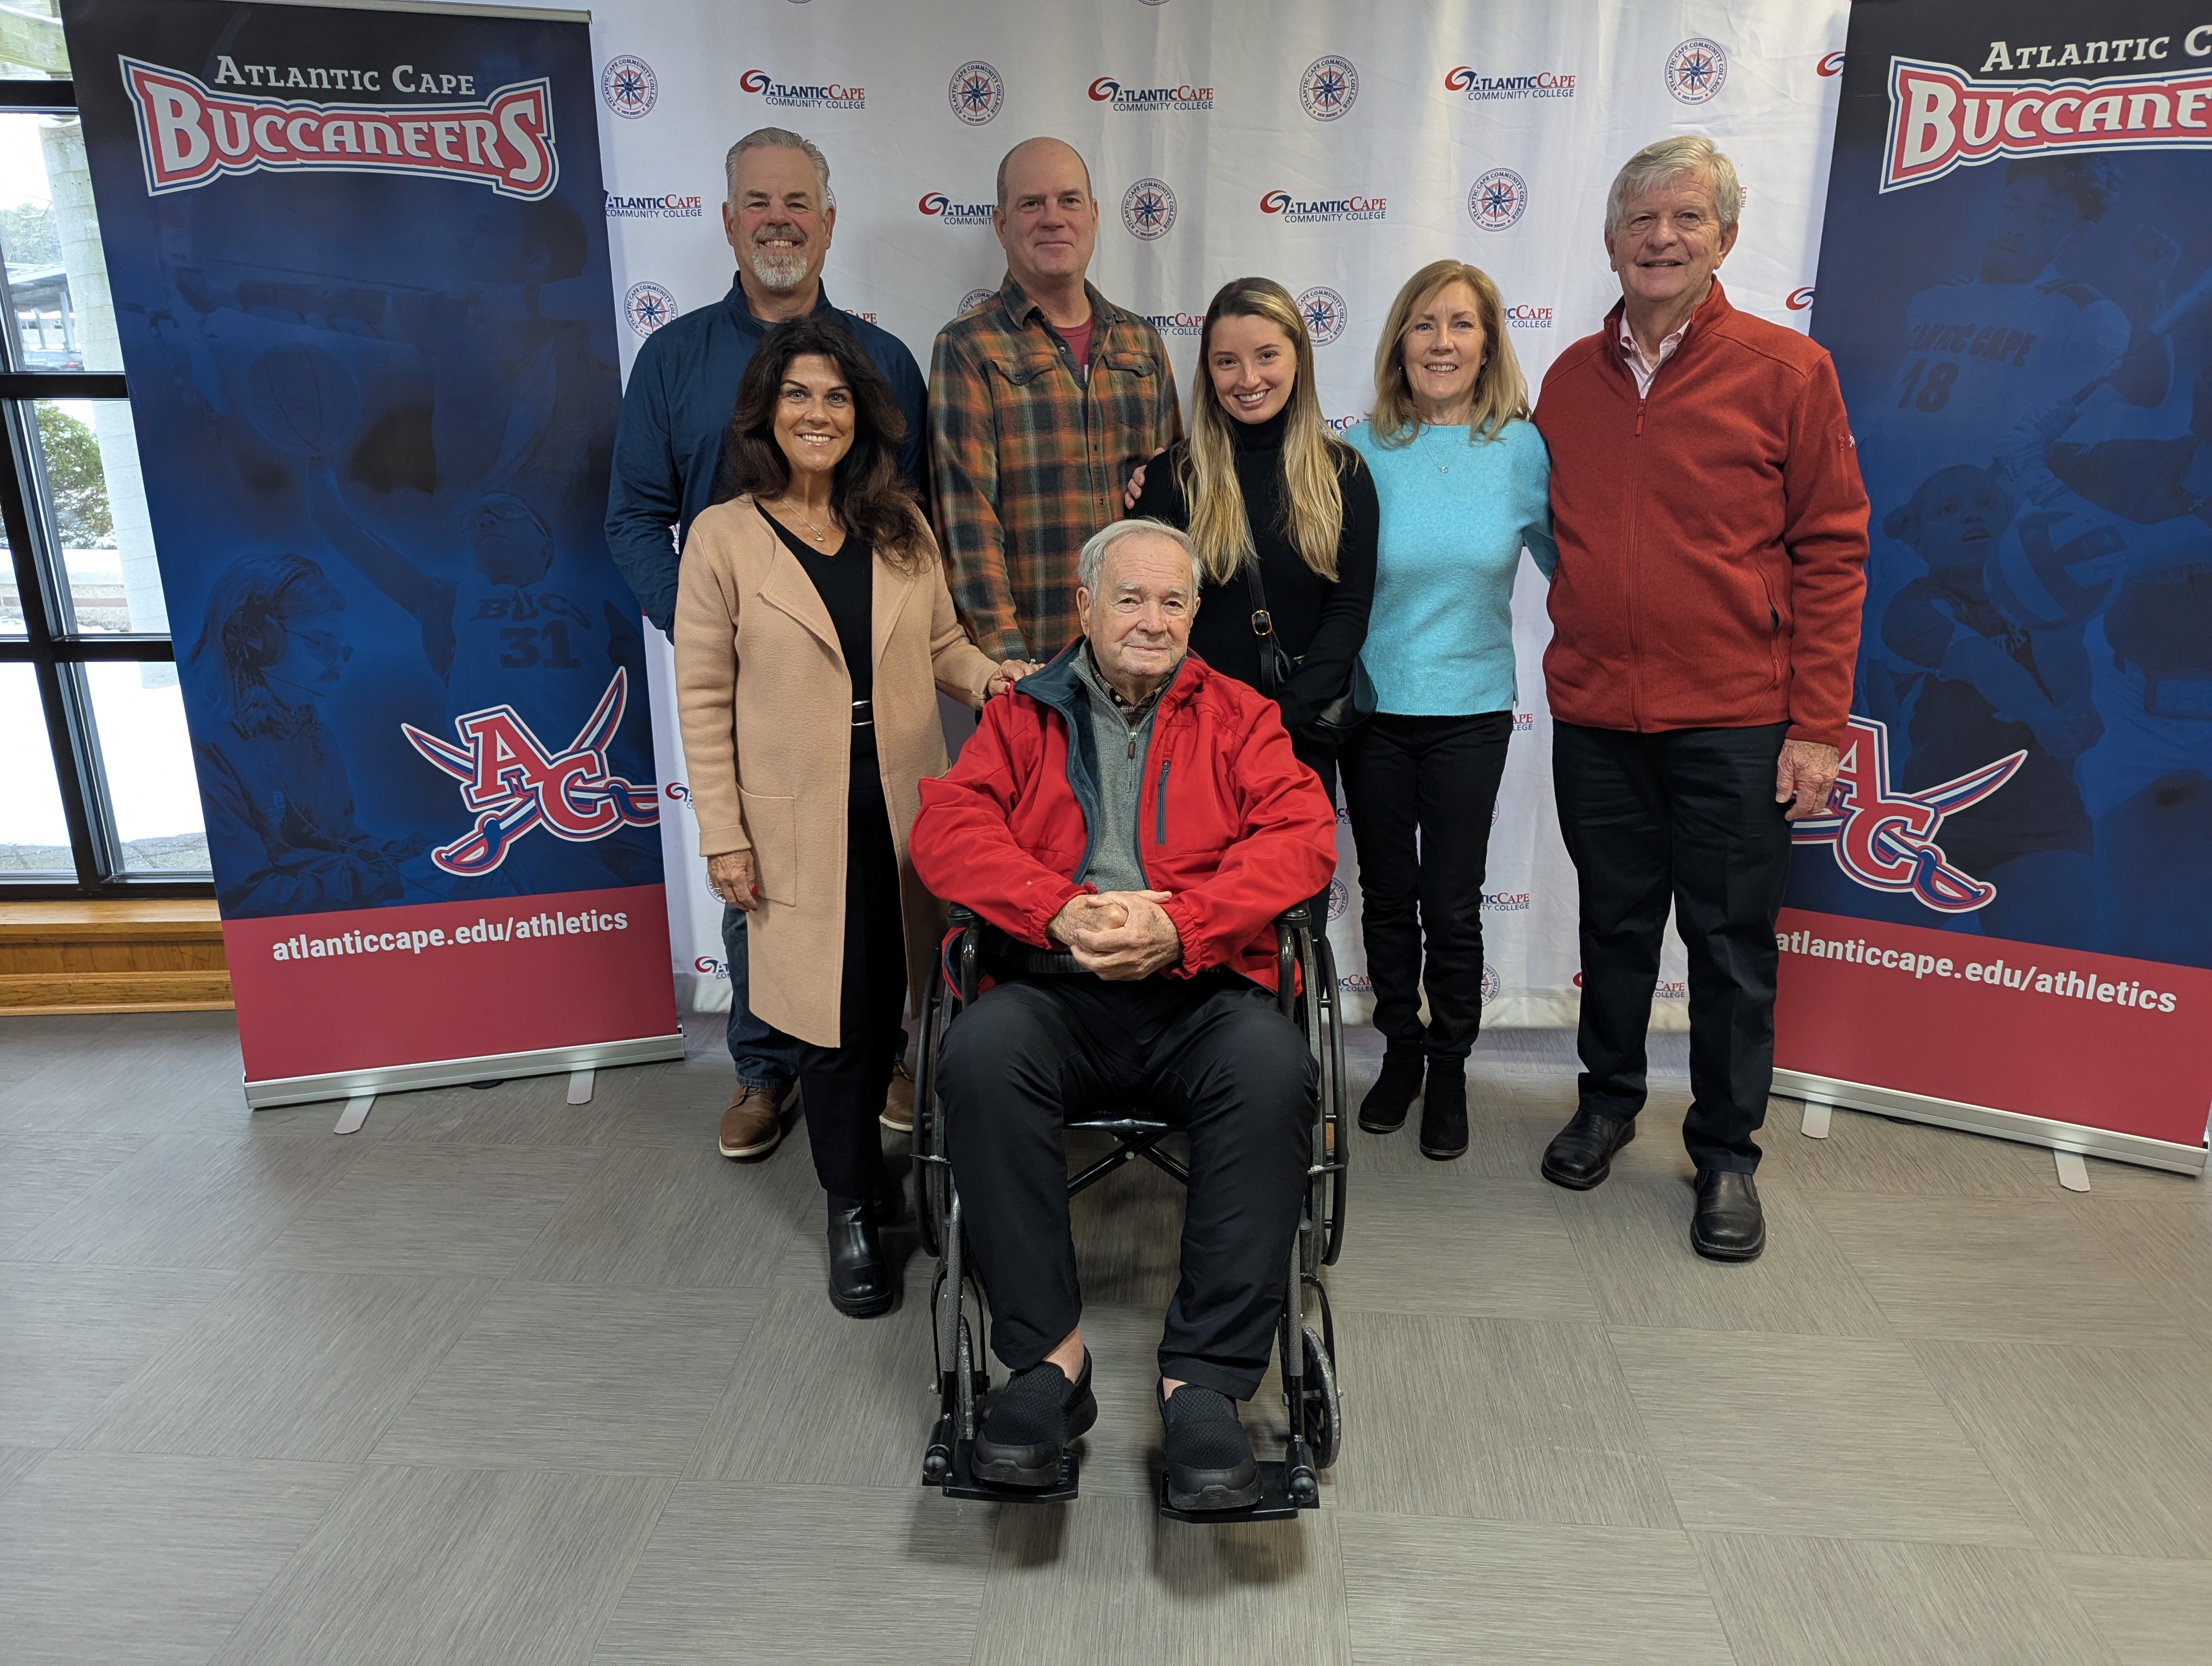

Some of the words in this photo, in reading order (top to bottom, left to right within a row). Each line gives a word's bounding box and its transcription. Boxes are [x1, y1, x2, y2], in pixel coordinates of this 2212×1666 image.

[1668, 58, 1678, 92] ATLANTIC
[1674, 44, 1689, 58] CAPE
[1689, 42, 1723, 62] COMMUNITY
[1709, 63, 1724, 94] COLLEGE
[1980, 36, 2169, 72] ATLANTIC
[214, 55, 380, 92] ATLANTIC
[391, 65, 475, 95] CAPE
[607, 62, 619, 75] CAPE
[619, 59, 652, 78] COMMUNITY
[955, 69, 967, 82] CAPE
[967, 65, 999, 84] COMMUNITY
[604, 75, 616, 107] ATLANTIC
[645, 79, 655, 108] COLLEGE
[952, 82, 963, 114] ATLANTIC
[1303, 78, 1313, 110] ATLANTIC
[1308, 63, 1321, 77] CAPE
[1321, 59, 1354, 78] COMMUNITY
[1343, 78, 1355, 109] COLLEGE
[1468, 91, 1529, 100] COMMUNITY
[1532, 89, 1574, 98] COLLEGE
[766, 97, 822, 108] COMMUNITY
[826, 100, 865, 109] COLLEGE
[991, 84, 1001, 114] COLLEGE
[1113, 102, 1171, 112] COMMUNITY
[1174, 101, 1213, 111] COLLEGE
[143, 79, 543, 184] BUCCANEERS
[1902, 78, 2212, 169] BUCCANE
[1128, 185, 1140, 199] CAPE
[1141, 182, 1172, 200] COMMUNITY
[1471, 189, 1481, 220] ATLANTIC
[1477, 175, 1490, 189] CAPE
[1490, 171, 1523, 190] COMMUNITY
[1511, 191, 1525, 220] COLLEGE
[606, 209, 660, 218] COMMUNITY
[663, 209, 703, 217] COLLEGE
[1124, 199, 1136, 229] ATLANTIC
[1163, 201, 1174, 229] COLLEGE
[1284, 214, 1342, 223] COMMUNITY
[1346, 212, 1386, 221] COLLEGE
[629, 287, 640, 300] CAPE
[639, 285, 672, 303] COMMUNITY
[963, 296, 974, 307] CAPE
[627, 300, 640, 329] ATLANTIC
[1298, 293, 1310, 306] CAPE
[1310, 290, 1342, 307] COMMUNITY
[1333, 308, 1344, 336] COLLEGE
[1512, 320, 1552, 328] COLLEGE
[1898, 358, 1959, 413] 18
[499, 619, 581, 669] 31
[1337, 893, 1346, 913] COLLEGE
[272, 909, 628, 962] atlanticcape.edu/athletics
[1776, 930, 2177, 1013] atlanticcape.edu/athletics
[1488, 978, 1497, 998] COLLEGE
